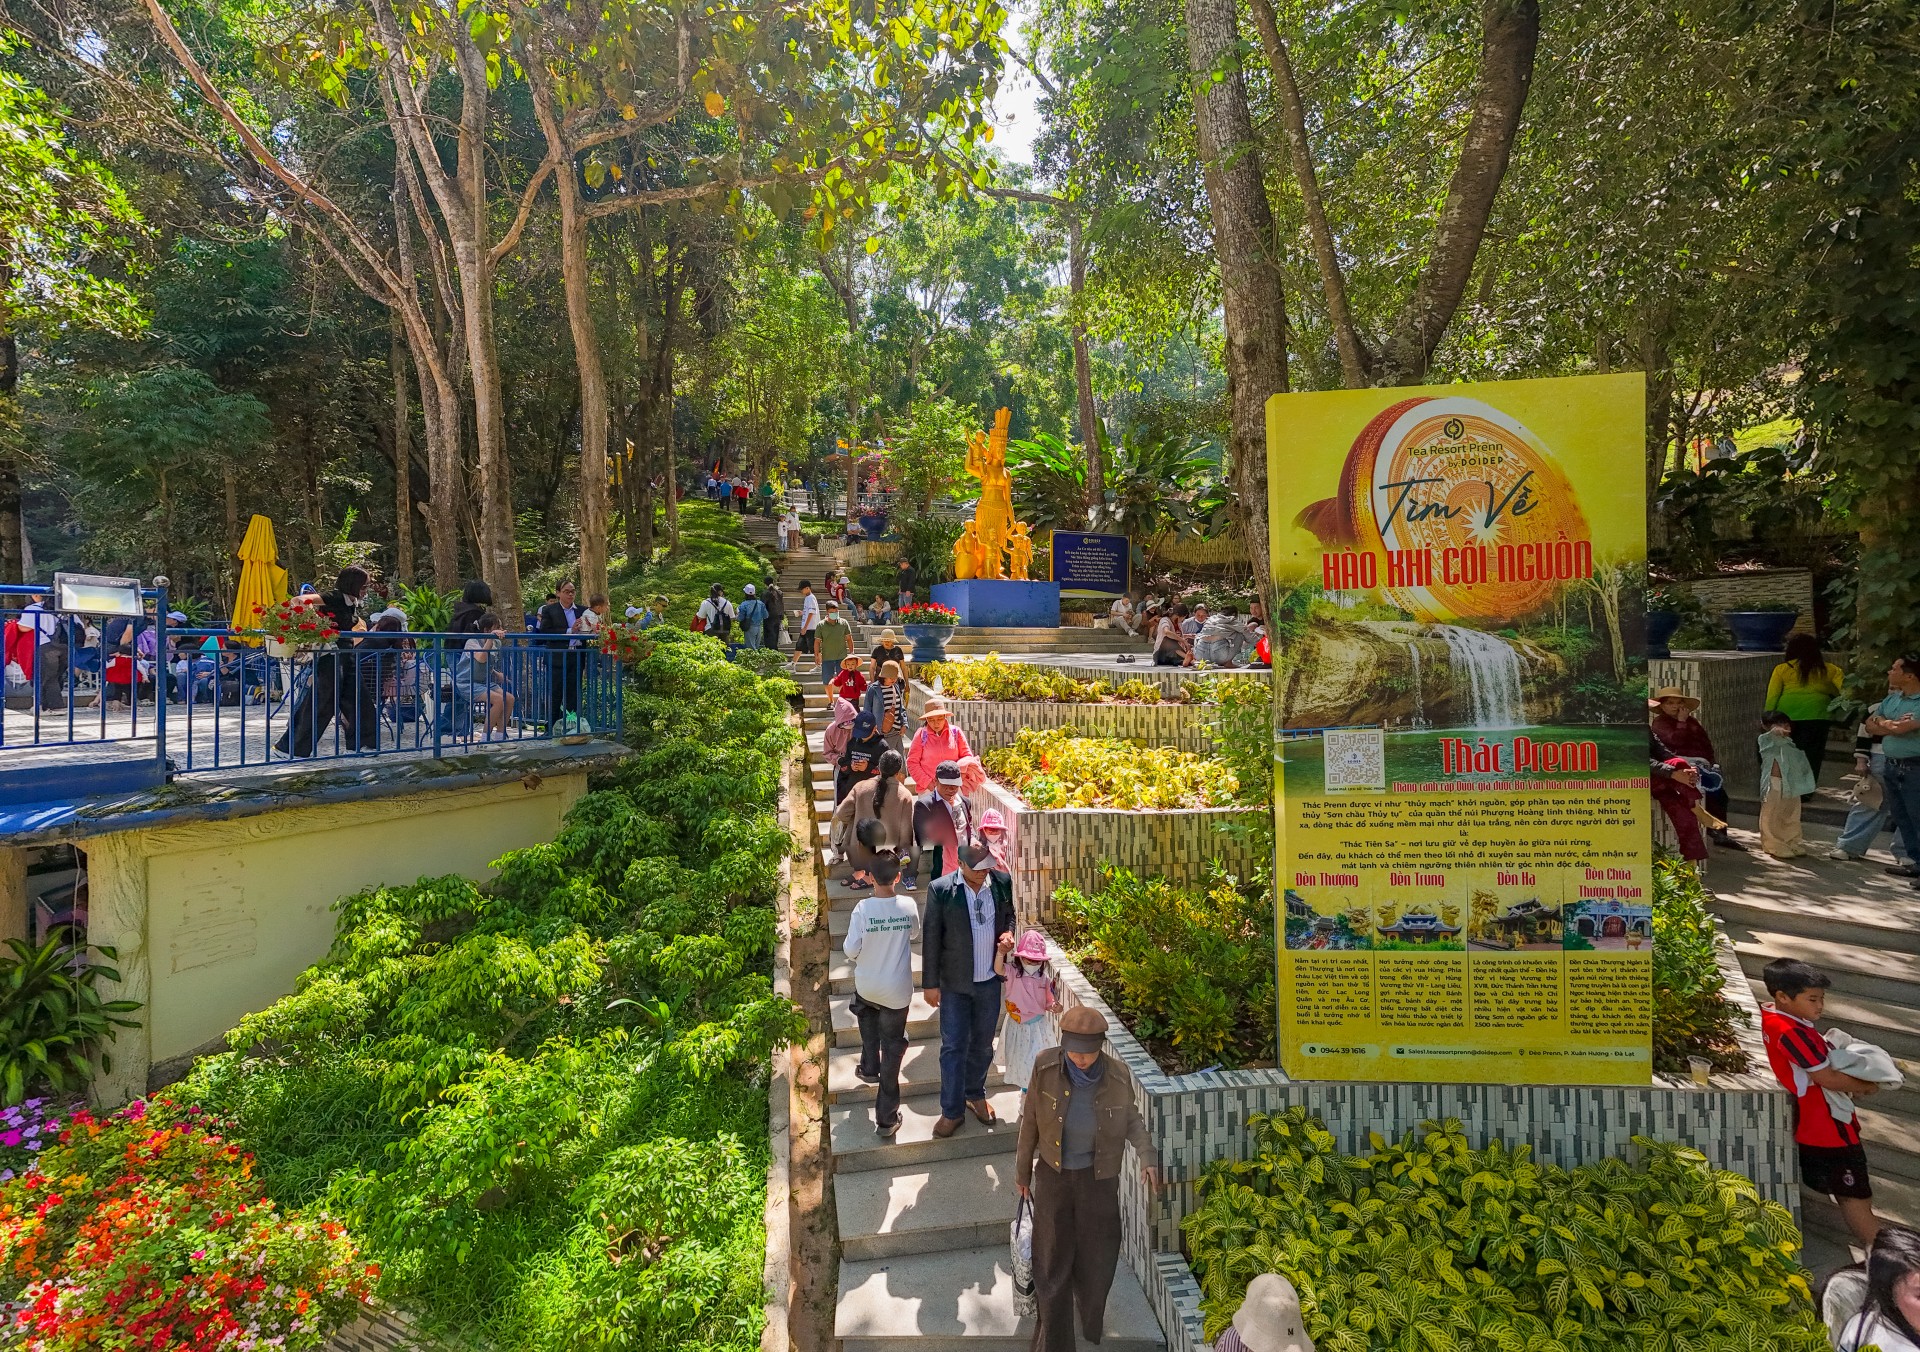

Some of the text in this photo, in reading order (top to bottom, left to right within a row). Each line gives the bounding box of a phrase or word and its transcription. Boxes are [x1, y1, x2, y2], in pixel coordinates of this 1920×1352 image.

[1407, 442, 1504, 457] Tea Resort Prenn
[1448, 456, 1504, 469] by DOIDEP
[1379, 470, 1539, 537] Tìm Về
[1322, 530, 1593, 591] HÀO KHÍ CỘI NGUỒN
[1439, 736, 1599, 774] Thác Prenn
[1631, 779, 1648, 788] 1998
[1405, 800, 1426, 808] “thủy
[1430, 800, 1454, 808] mạch”
[1458, 799, 1476, 809] khởi
[1480, 799, 1507, 807] nguồn,
[1510, 799, 1525, 807] góp
[1528, 798, 1549, 807] phần
[1604, 798, 1630, 806] phong
[1302, 811, 1321, 819] thủy
[1368, 810, 1388, 819] Thủy
[1426, 809, 1446, 818] quần
[1481, 809, 1515, 818] Phượng
[1518, 809, 1544, 817] Hoàng
[1566, 808, 1595, 816] thiêng.
[1313, 821, 1332, 829] dòng
[1370, 820, 1394, 828] xuống
[1420, 820, 1434, 828] mại
[1489, 818, 1511, 827] trắng,
[1577, 818, 1602, 826] người
[1623, 818, 1635, 826] gọi
[1443, 840, 1456, 848] giữ
[1472, 840, 1487, 848] đẹp
[1490, 839, 1516, 847] huyền
[1532, 839, 1550, 847] giữa
[1570, 839, 1592, 847] rừng.
[1488, 851, 1514, 859] xuyên
[1555, 850, 1579, 858] nước,
[1602, 850, 1624, 858] nhận
[1360, 862, 1377, 870] lạnh
[1505, 861, 1515, 870] từ
[1518, 861, 1532, 869] góc
[1557, 861, 1572, 869] độc
[1574, 861, 1592, 870] đáo.
[1296, 873, 1358, 887] Đền Thượng
[1390, 873, 1444, 887] Đền Trung
[1498, 872, 1535, 885] Đền Hạ
